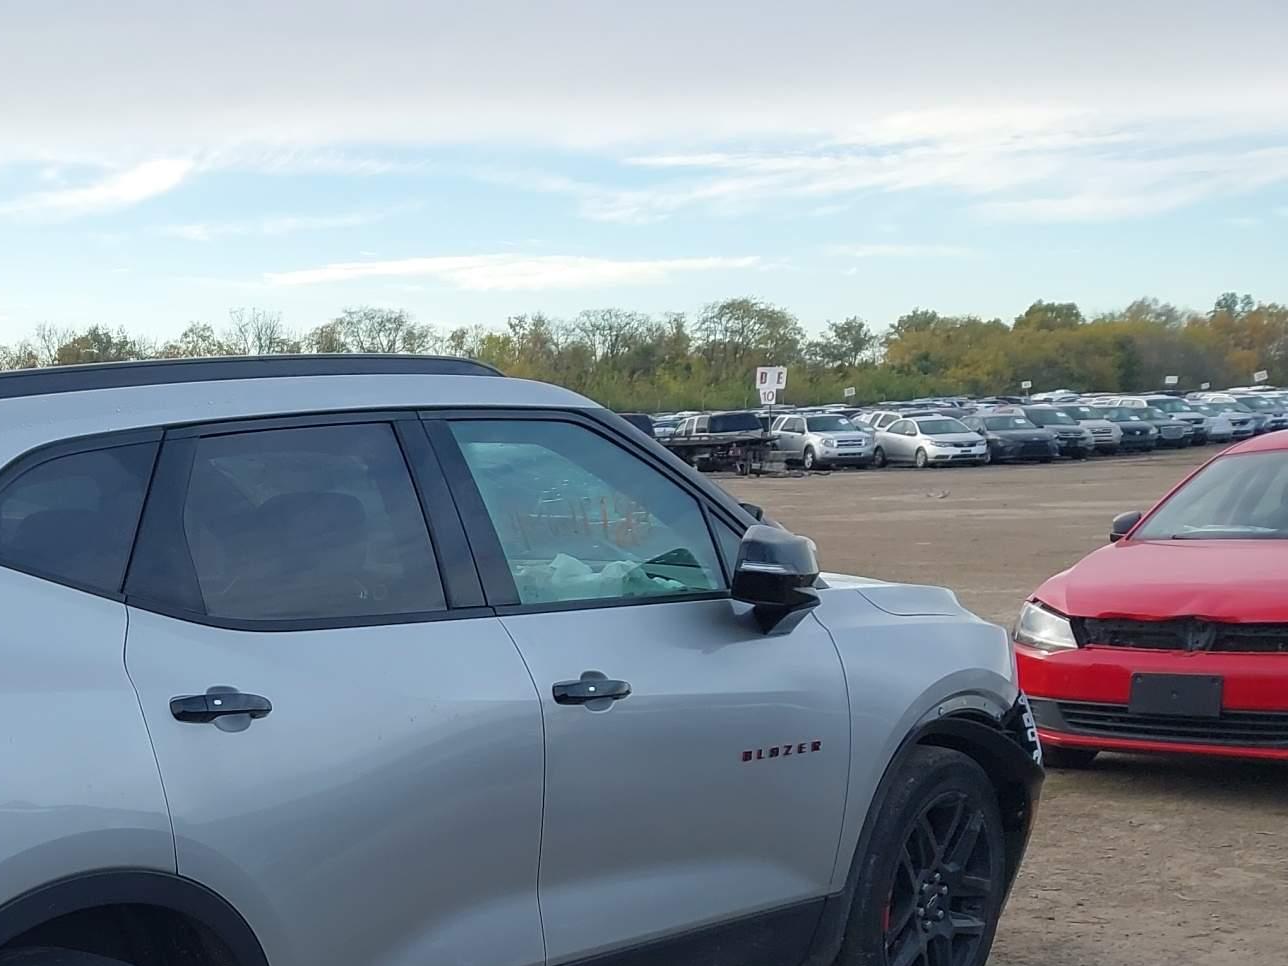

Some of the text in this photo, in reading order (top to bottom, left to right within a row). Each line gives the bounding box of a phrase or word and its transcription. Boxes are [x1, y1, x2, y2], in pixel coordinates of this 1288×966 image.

[760, 371, 784, 384] D E
[762, 390, 775, 402] 10
[742, 740, 822, 762] BLAZER
